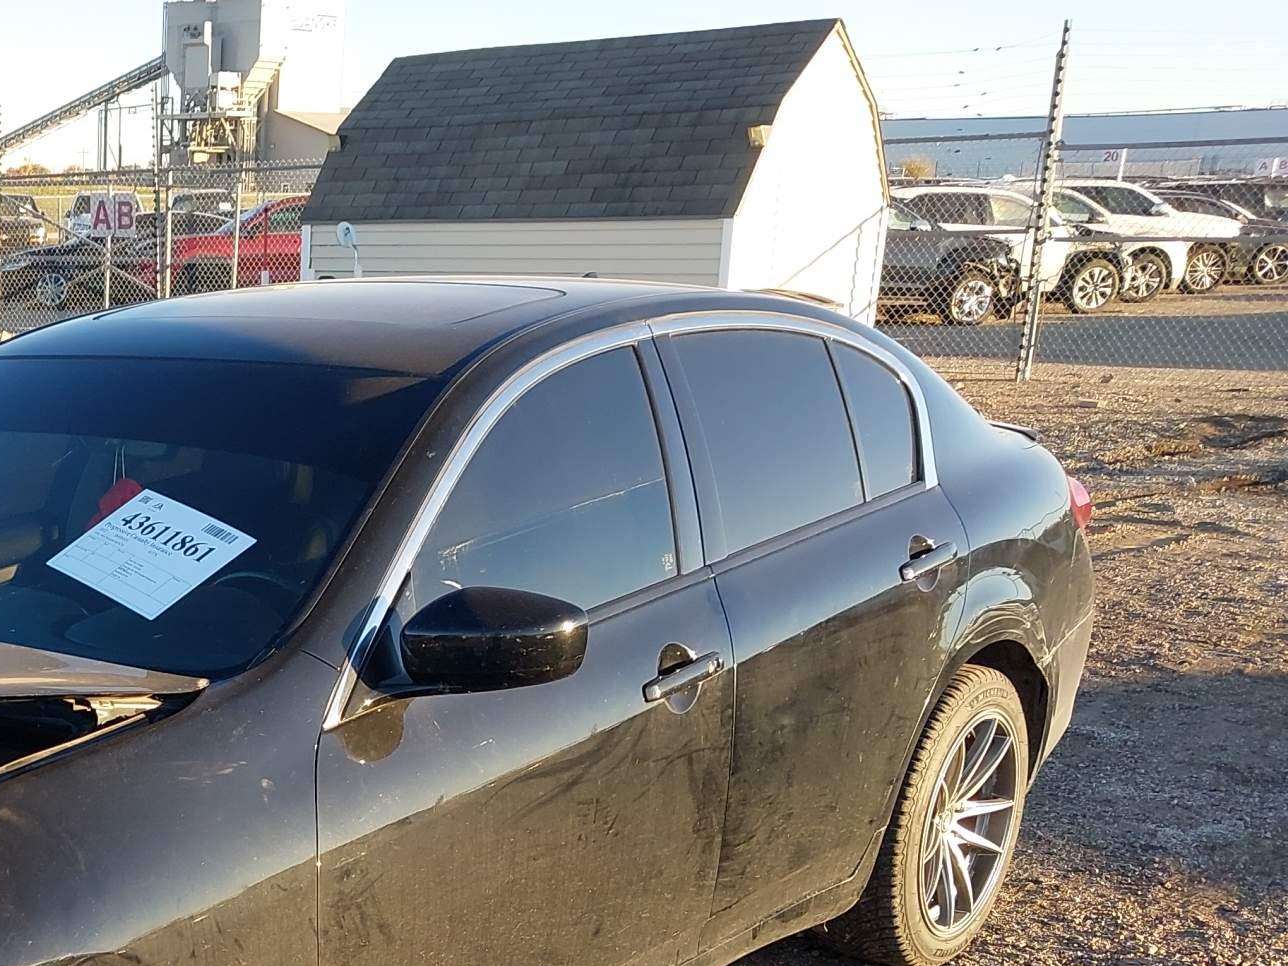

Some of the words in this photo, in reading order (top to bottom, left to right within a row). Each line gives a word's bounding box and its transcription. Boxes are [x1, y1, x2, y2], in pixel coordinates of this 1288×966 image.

[1103, 151, 1119, 162] 20
[1258, 161, 1268, 171] A
[121, 512, 217, 563] 43611861
